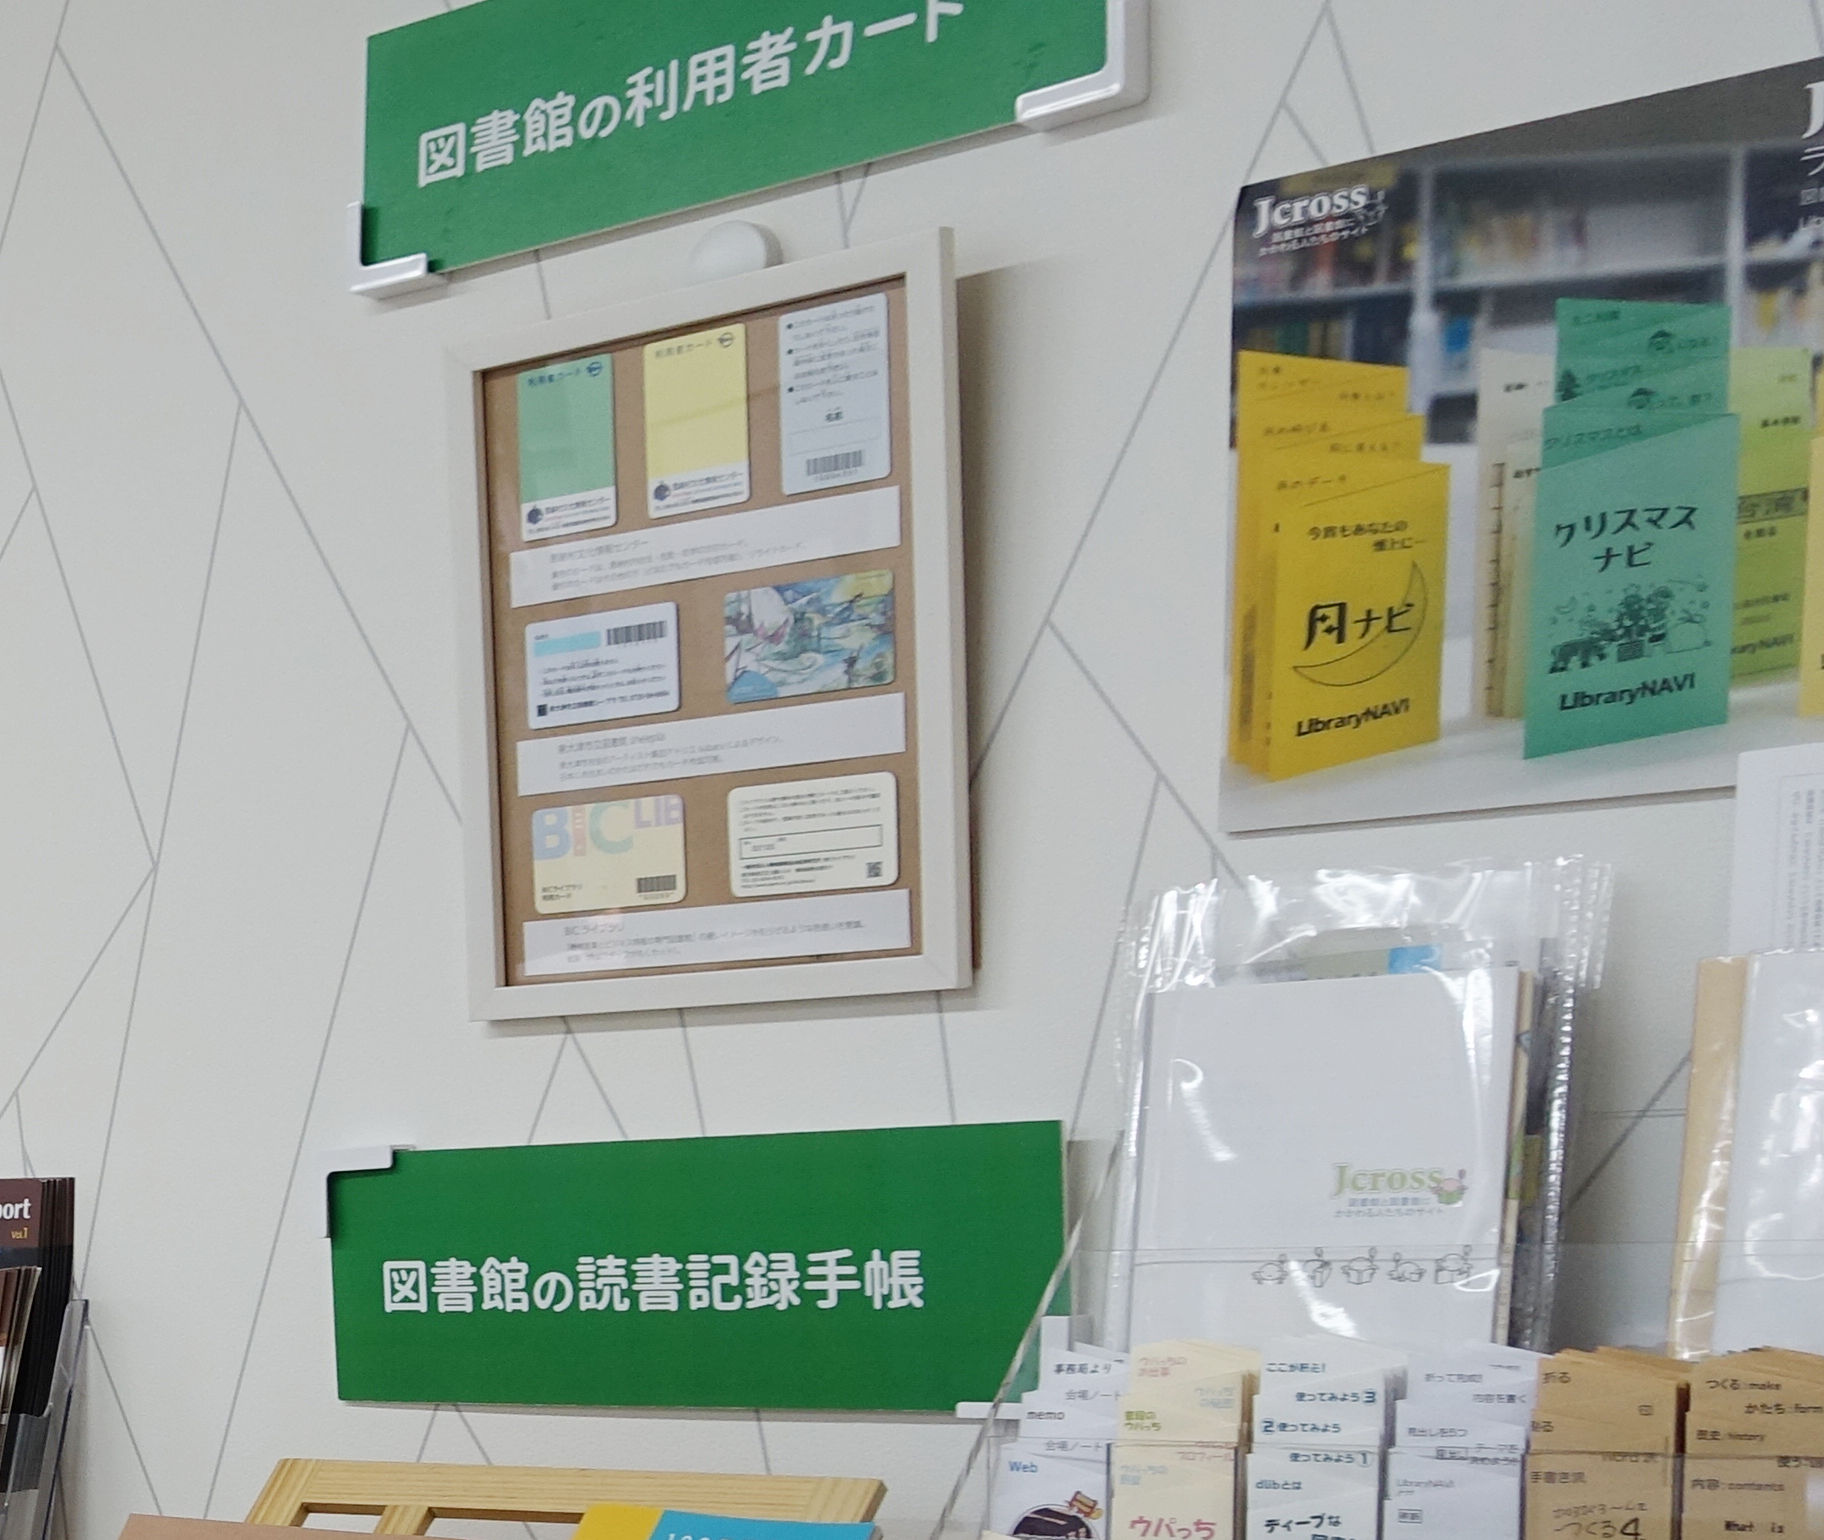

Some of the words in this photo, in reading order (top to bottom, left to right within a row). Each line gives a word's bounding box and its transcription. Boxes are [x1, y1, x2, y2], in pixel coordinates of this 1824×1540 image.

[1252, 183, 1370, 238] Jcross
[1554, 504, 1699, 551] クリスマス
[1593, 541, 1654, 575] ナビ
[1303, 602, 1415, 653] 月ナビ
[1557, 671, 1697, 712] LibraryNAVI
[1295, 697, 1411, 739] LibraryNAVI
[1331, 1163, 1444, 1198] Jcross
[381, 1248, 924, 1314] 図書館の読書記録手帳
[1053, 1361, 1113, 1376] 事務局より
[1542, 1371, 1572, 1385] 折る
[1064, 1388, 1122, 1402] 会場ノート
[1295, 1391, 1361, 1403] 使ってみよう
[1026, 1410, 1065, 1421] memo
[1276, 1422, 1342, 1434] 使ってみよう
[1177, 1450, 1235, 1462] プロフィール
[1008, 1460, 1039, 1474] Web
[1255, 1478, 1303, 1491] dlibとは
[1264, 1513, 1342, 1534] ディープな
[1723, 1520, 1755, 1533] What
[1769, 1522, 1786, 1534] is
